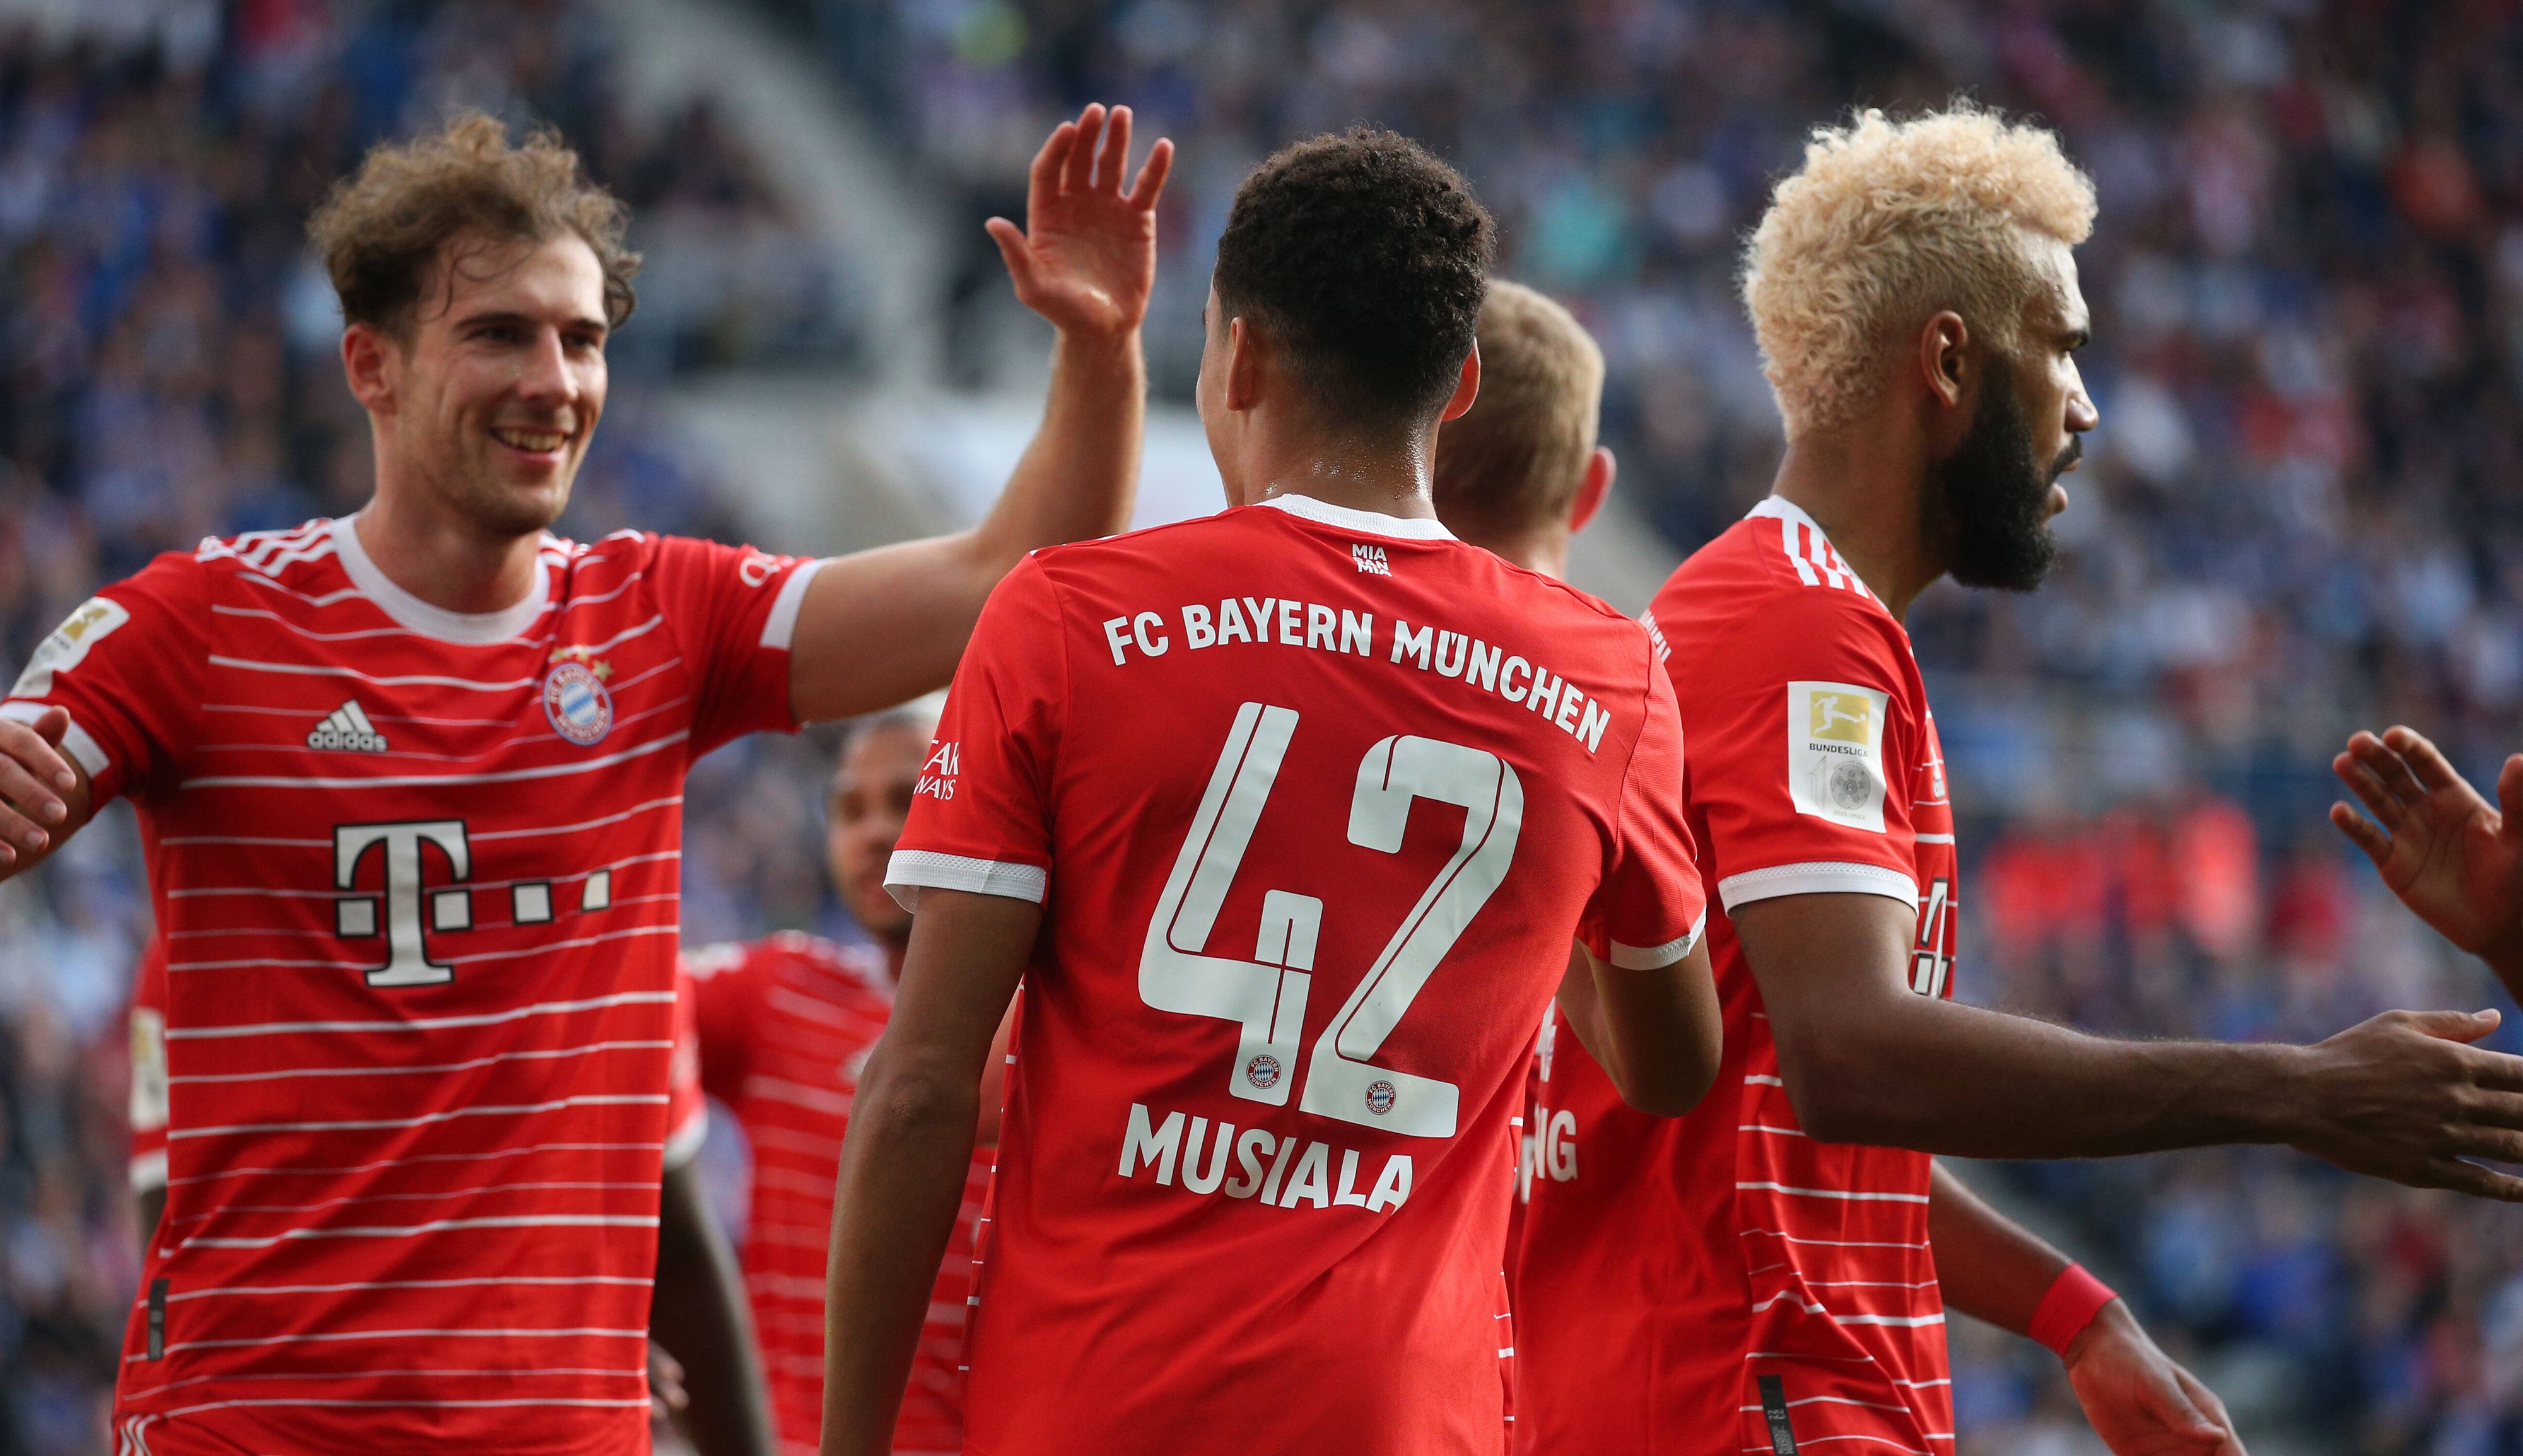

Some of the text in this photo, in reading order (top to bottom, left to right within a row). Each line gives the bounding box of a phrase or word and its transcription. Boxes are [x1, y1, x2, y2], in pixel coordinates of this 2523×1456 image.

[1352, 544, 1387, 562] MIA
[1103, 610, 1169, 667] FC
[1180, 596, 1374, 658] BAYERN
[1389, 619, 1612, 755] MÜNCHEN
[307, 730, 389, 754] adidas
[1809, 742, 1868, 757] BUNDESLIGA
[1137, 701, 1525, 1139] 42
[1259, 1057, 1279, 1072] BAYERN
[1118, 1102, 1414, 1216] MUSIALA
